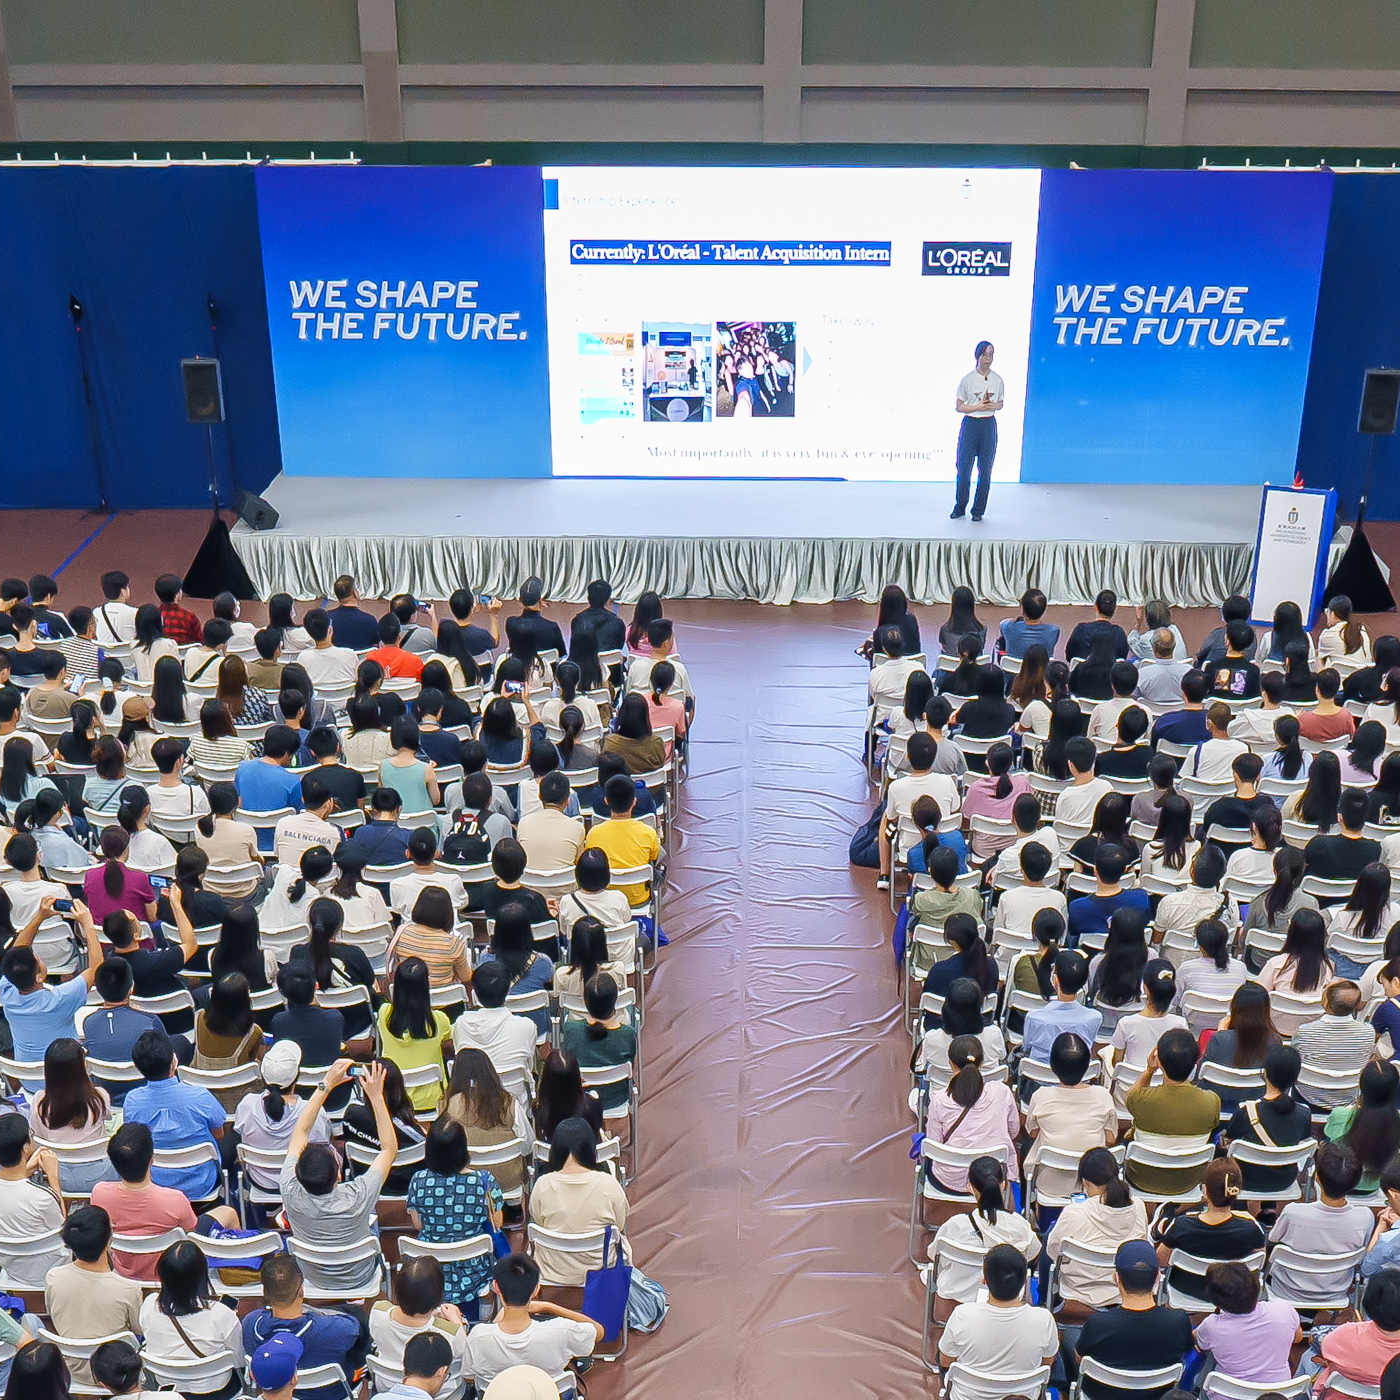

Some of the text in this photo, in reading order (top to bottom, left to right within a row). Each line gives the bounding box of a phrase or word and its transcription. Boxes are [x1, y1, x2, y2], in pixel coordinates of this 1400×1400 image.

[571, 244, 646, 264] Currently:
[647, 244, 701, 261] L'Oréal
[711, 244, 759, 261] Talent
[760, 244, 842, 265] Acquisition
[844, 245, 891, 262] Intern
[928, 248, 1009, 267] L'ORÉAL
[946, 266, 990, 275] GROUPE
[289, 279, 479, 308] WE SHAPE
[1054, 284, 1249, 314] WE SHAPE
[292, 312, 527, 341] THE FUTURE.
[1052, 317, 1290, 347] THE FUTURE.
[283, 829, 332, 846] BALENCIAGA
